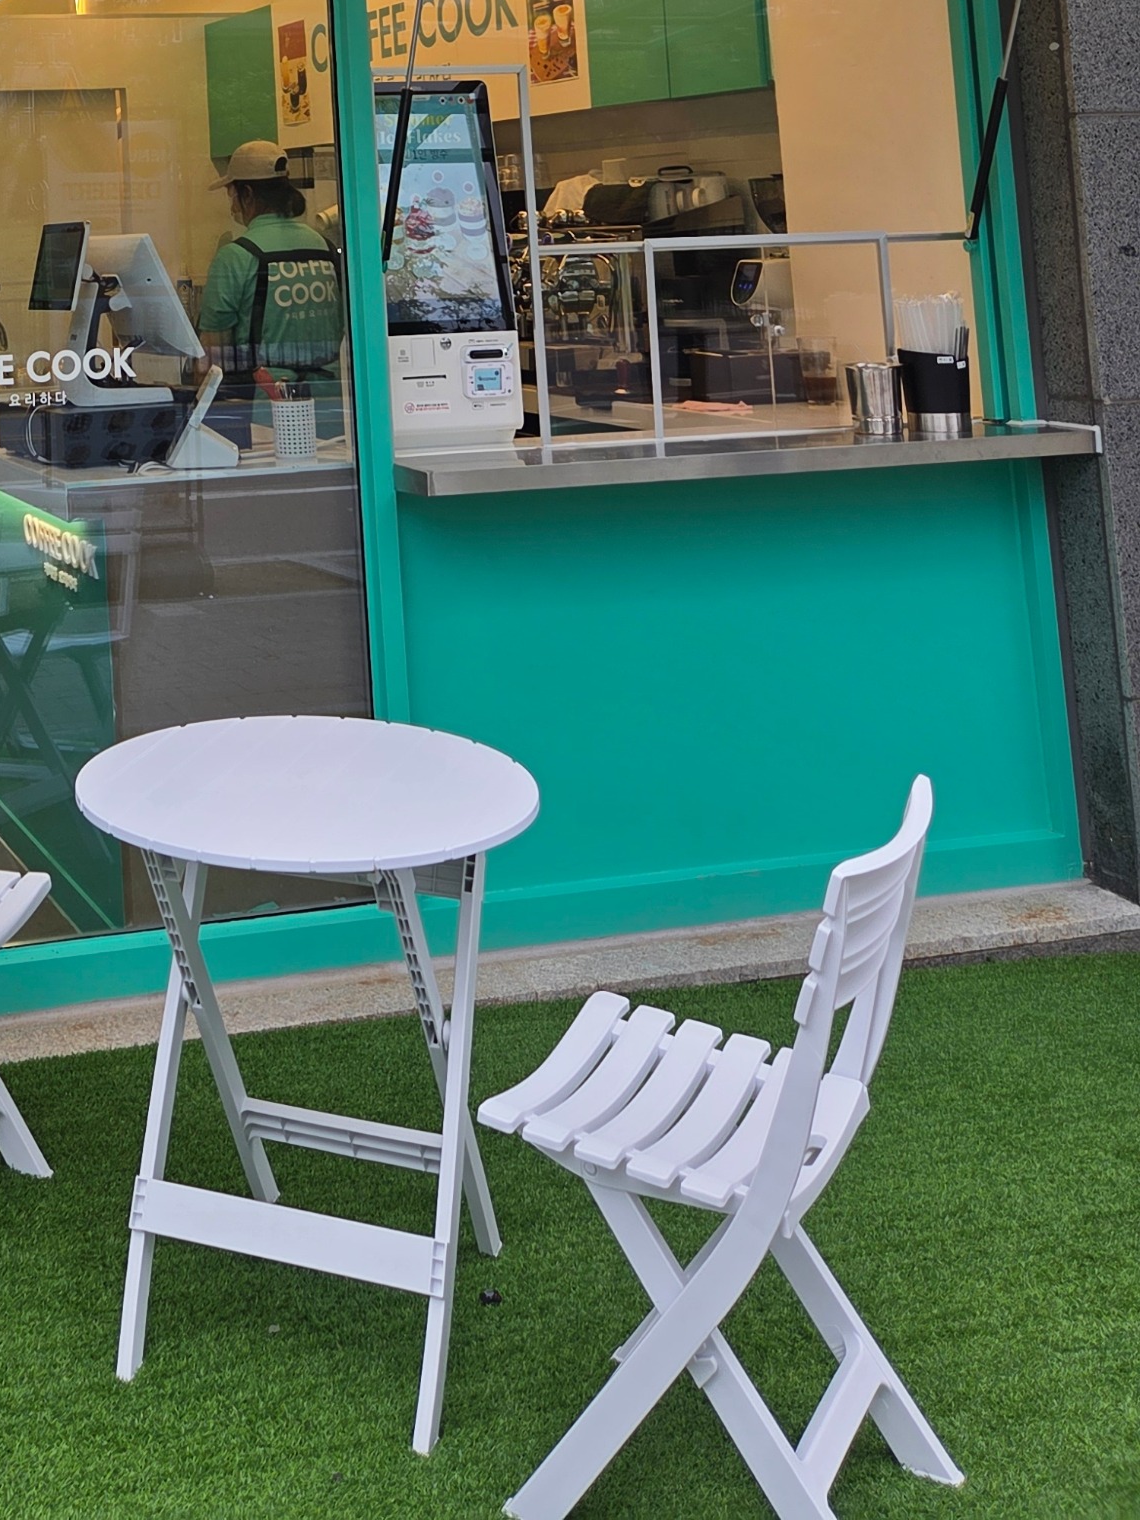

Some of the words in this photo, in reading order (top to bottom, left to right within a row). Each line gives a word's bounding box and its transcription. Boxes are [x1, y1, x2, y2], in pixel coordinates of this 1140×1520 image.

[274, 281, 337, 308] COOK
[25, 346, 137, 383] COOK
[9, 389, 69, 408] 요리하다
[23, 513, 63, 561] COFFEE
[61, 531, 99, 580] COOK
